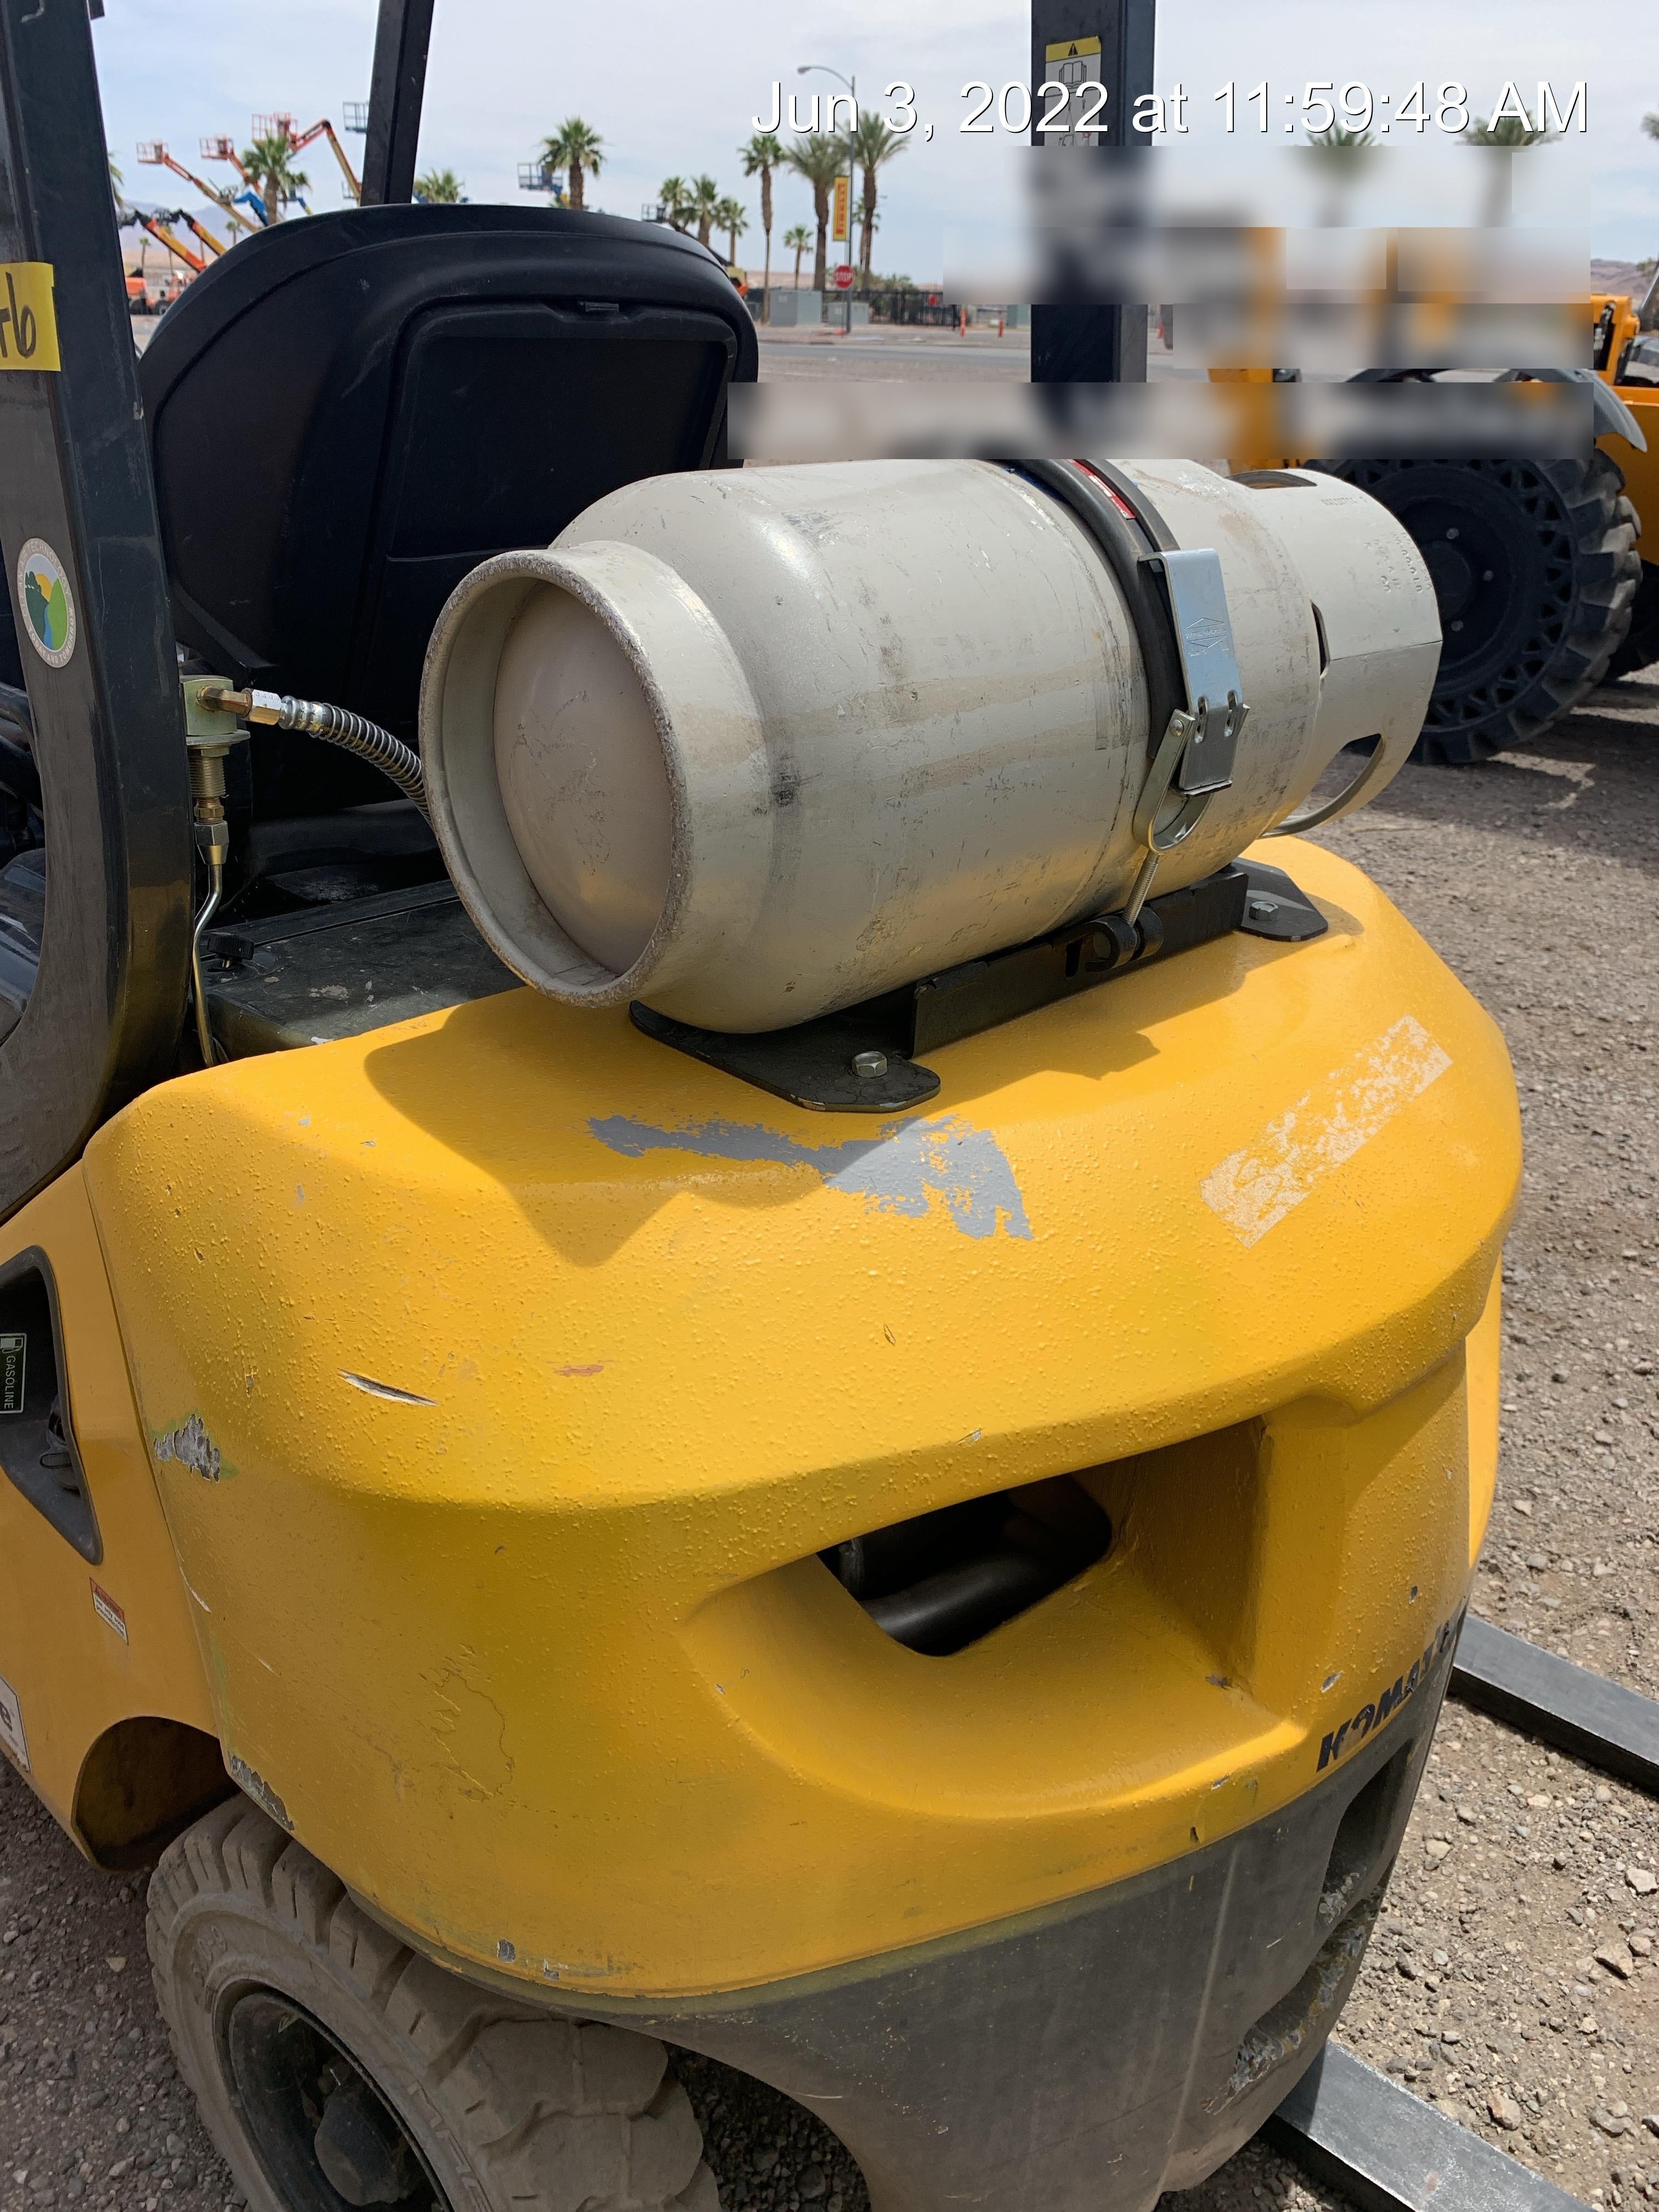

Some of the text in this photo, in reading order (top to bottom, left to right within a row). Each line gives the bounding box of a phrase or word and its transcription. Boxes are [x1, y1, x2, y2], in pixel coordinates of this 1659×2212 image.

[834, 272, 853, 282] STOP
[18, 573, 27, 617] CLEAN
[27, 542, 72, 597] TECHNOLOGY
[28, 608, 74, 664] TODAY AND TOMORROW
[4, 1356, 16, 1409] GASOLINE
